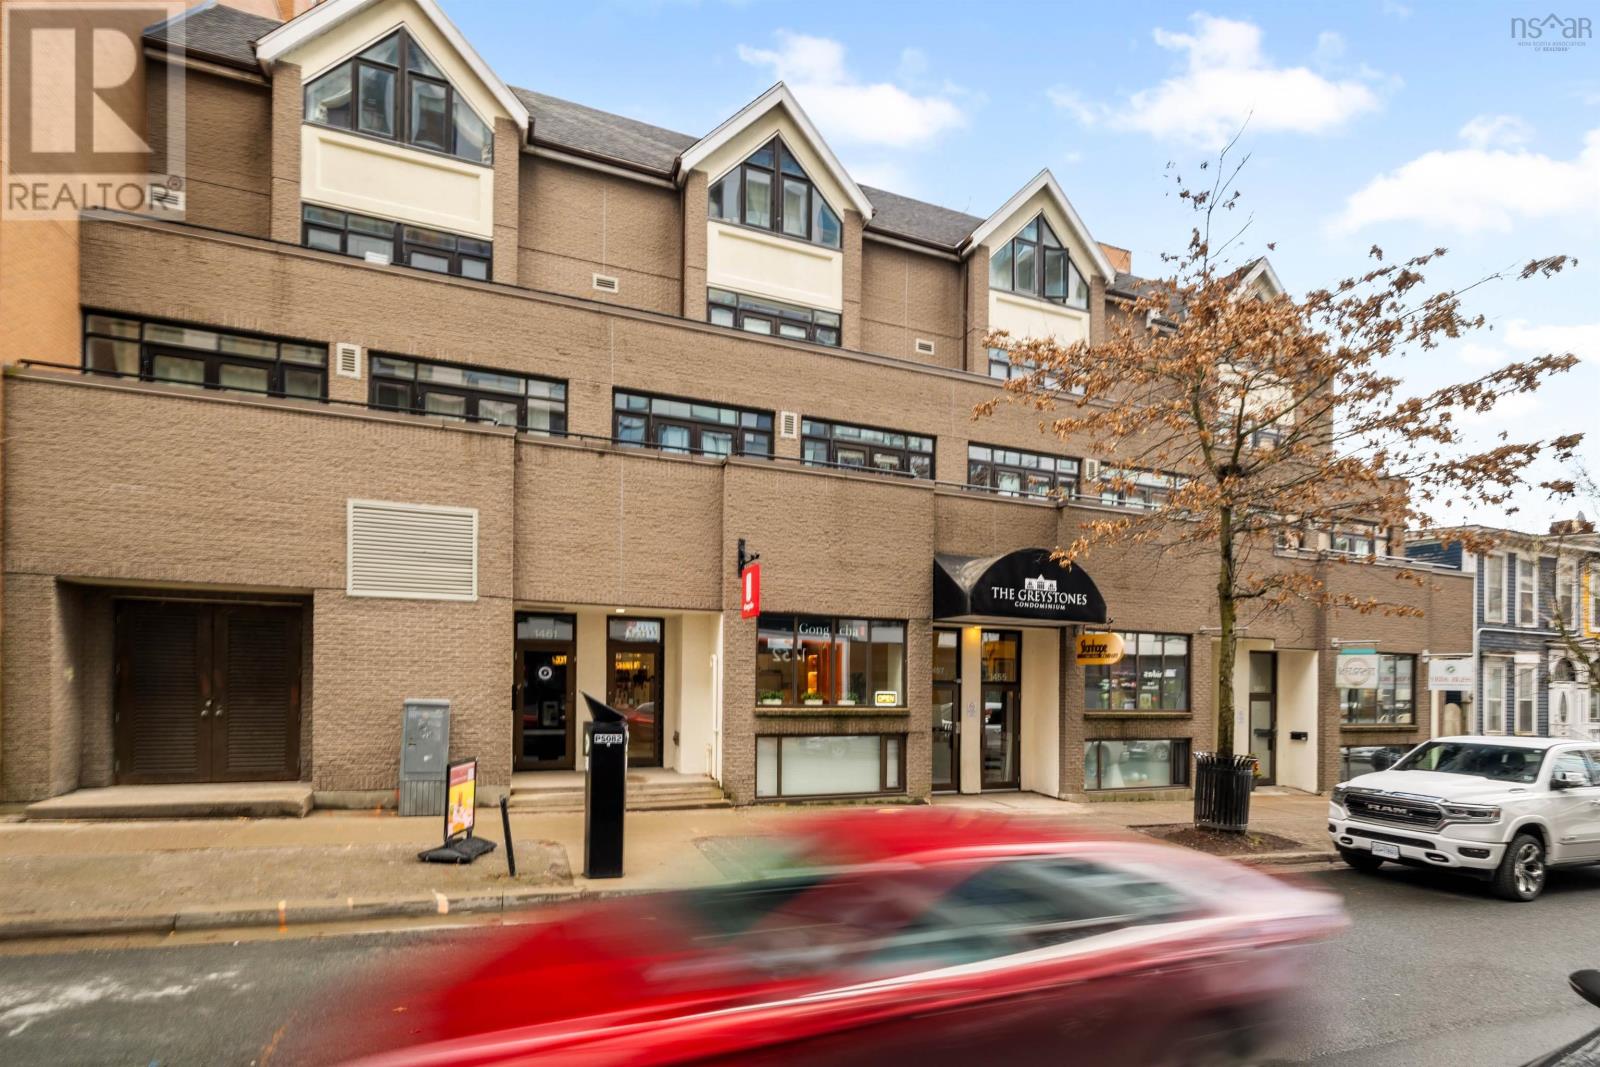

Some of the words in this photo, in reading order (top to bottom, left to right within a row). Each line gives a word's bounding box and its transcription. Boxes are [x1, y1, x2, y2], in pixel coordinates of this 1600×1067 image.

[992, 586, 1015, 600] THE
[1017, 588, 1088, 606] GREYSTONES
[1014, 600, 1067, 611] CONDOMINIUM
[799, 622, 831, 639] Gong
[876, 694, 895, 703] OPEN
[1366, 803, 1408, 815] RAM
